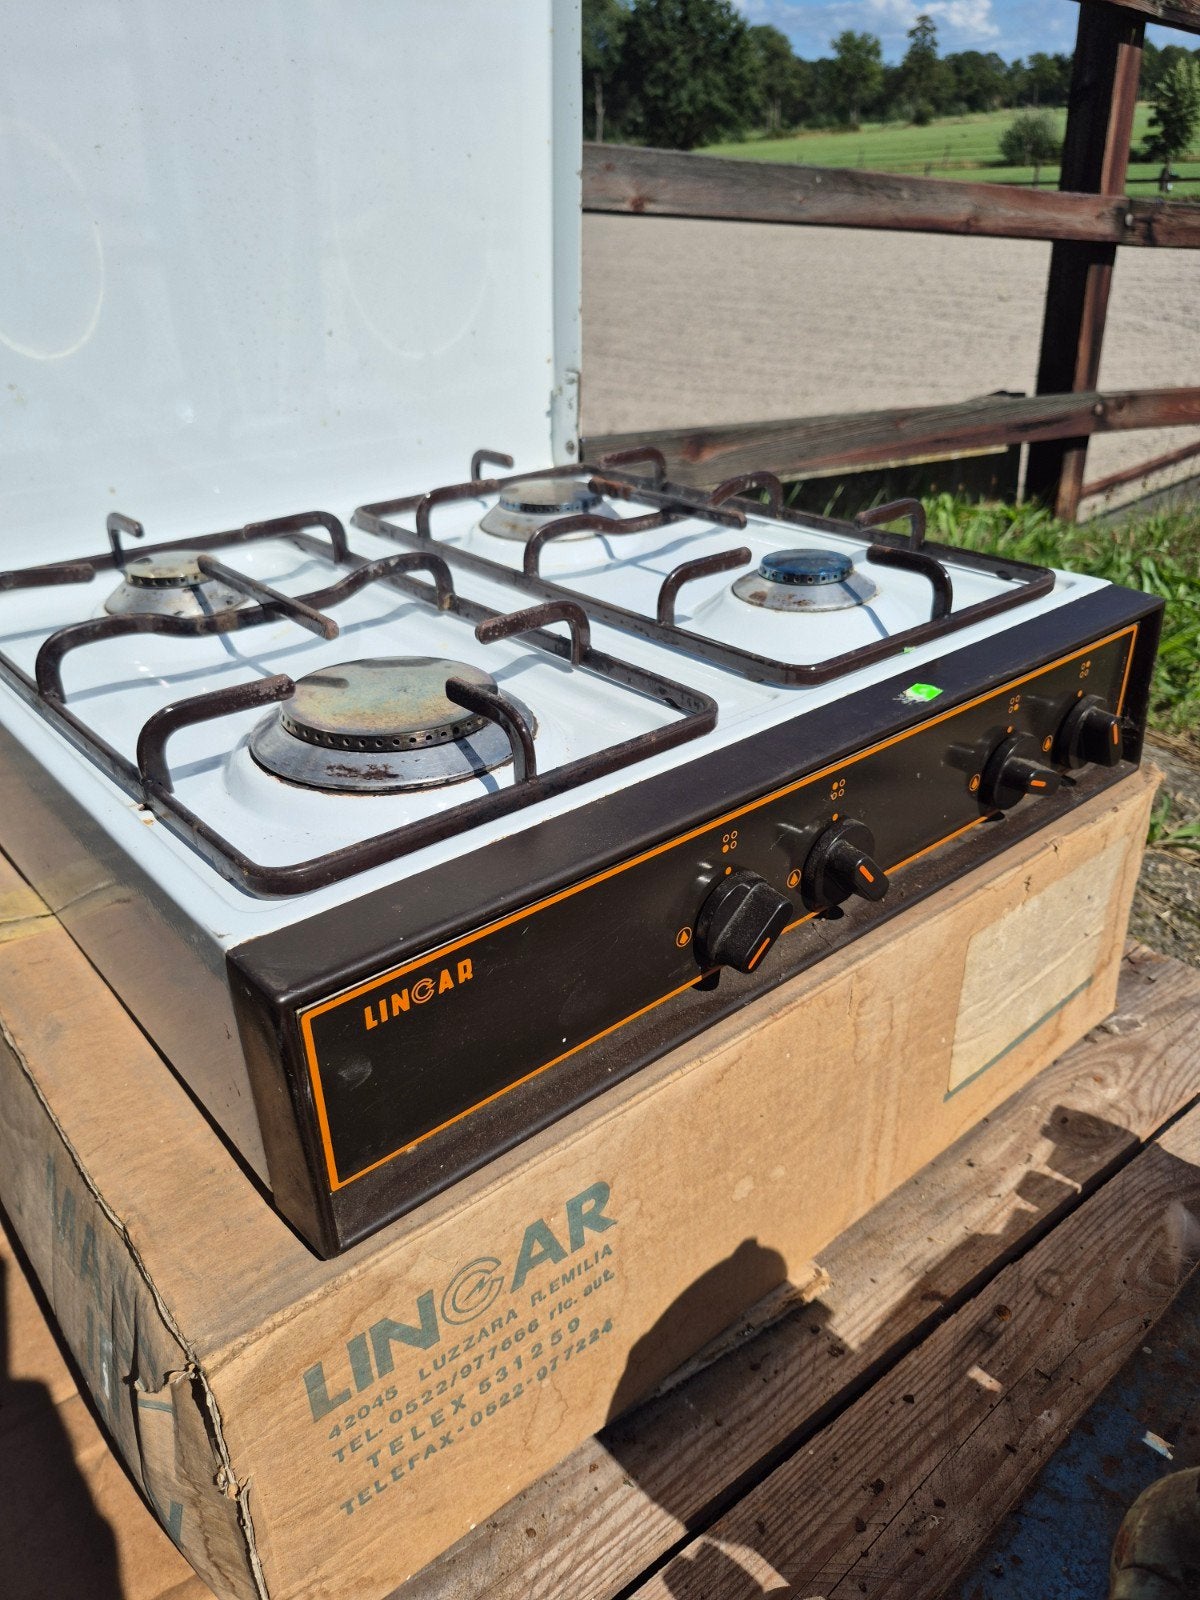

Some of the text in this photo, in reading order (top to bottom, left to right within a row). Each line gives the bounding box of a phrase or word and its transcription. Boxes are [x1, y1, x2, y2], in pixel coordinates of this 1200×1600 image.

[364, 958, 474, 1031] LINCAR
[303, 1181, 618, 1424] LINCAR
[328, 1384, 399, 1441] 42045
[418, 1308, 518, 1382] LUZZARA
[331, 1427, 384, 1464] TEL.
[388, 1318, 550, 1425] 0522/977666
[366, 1393, 467, 1469] TELEX
